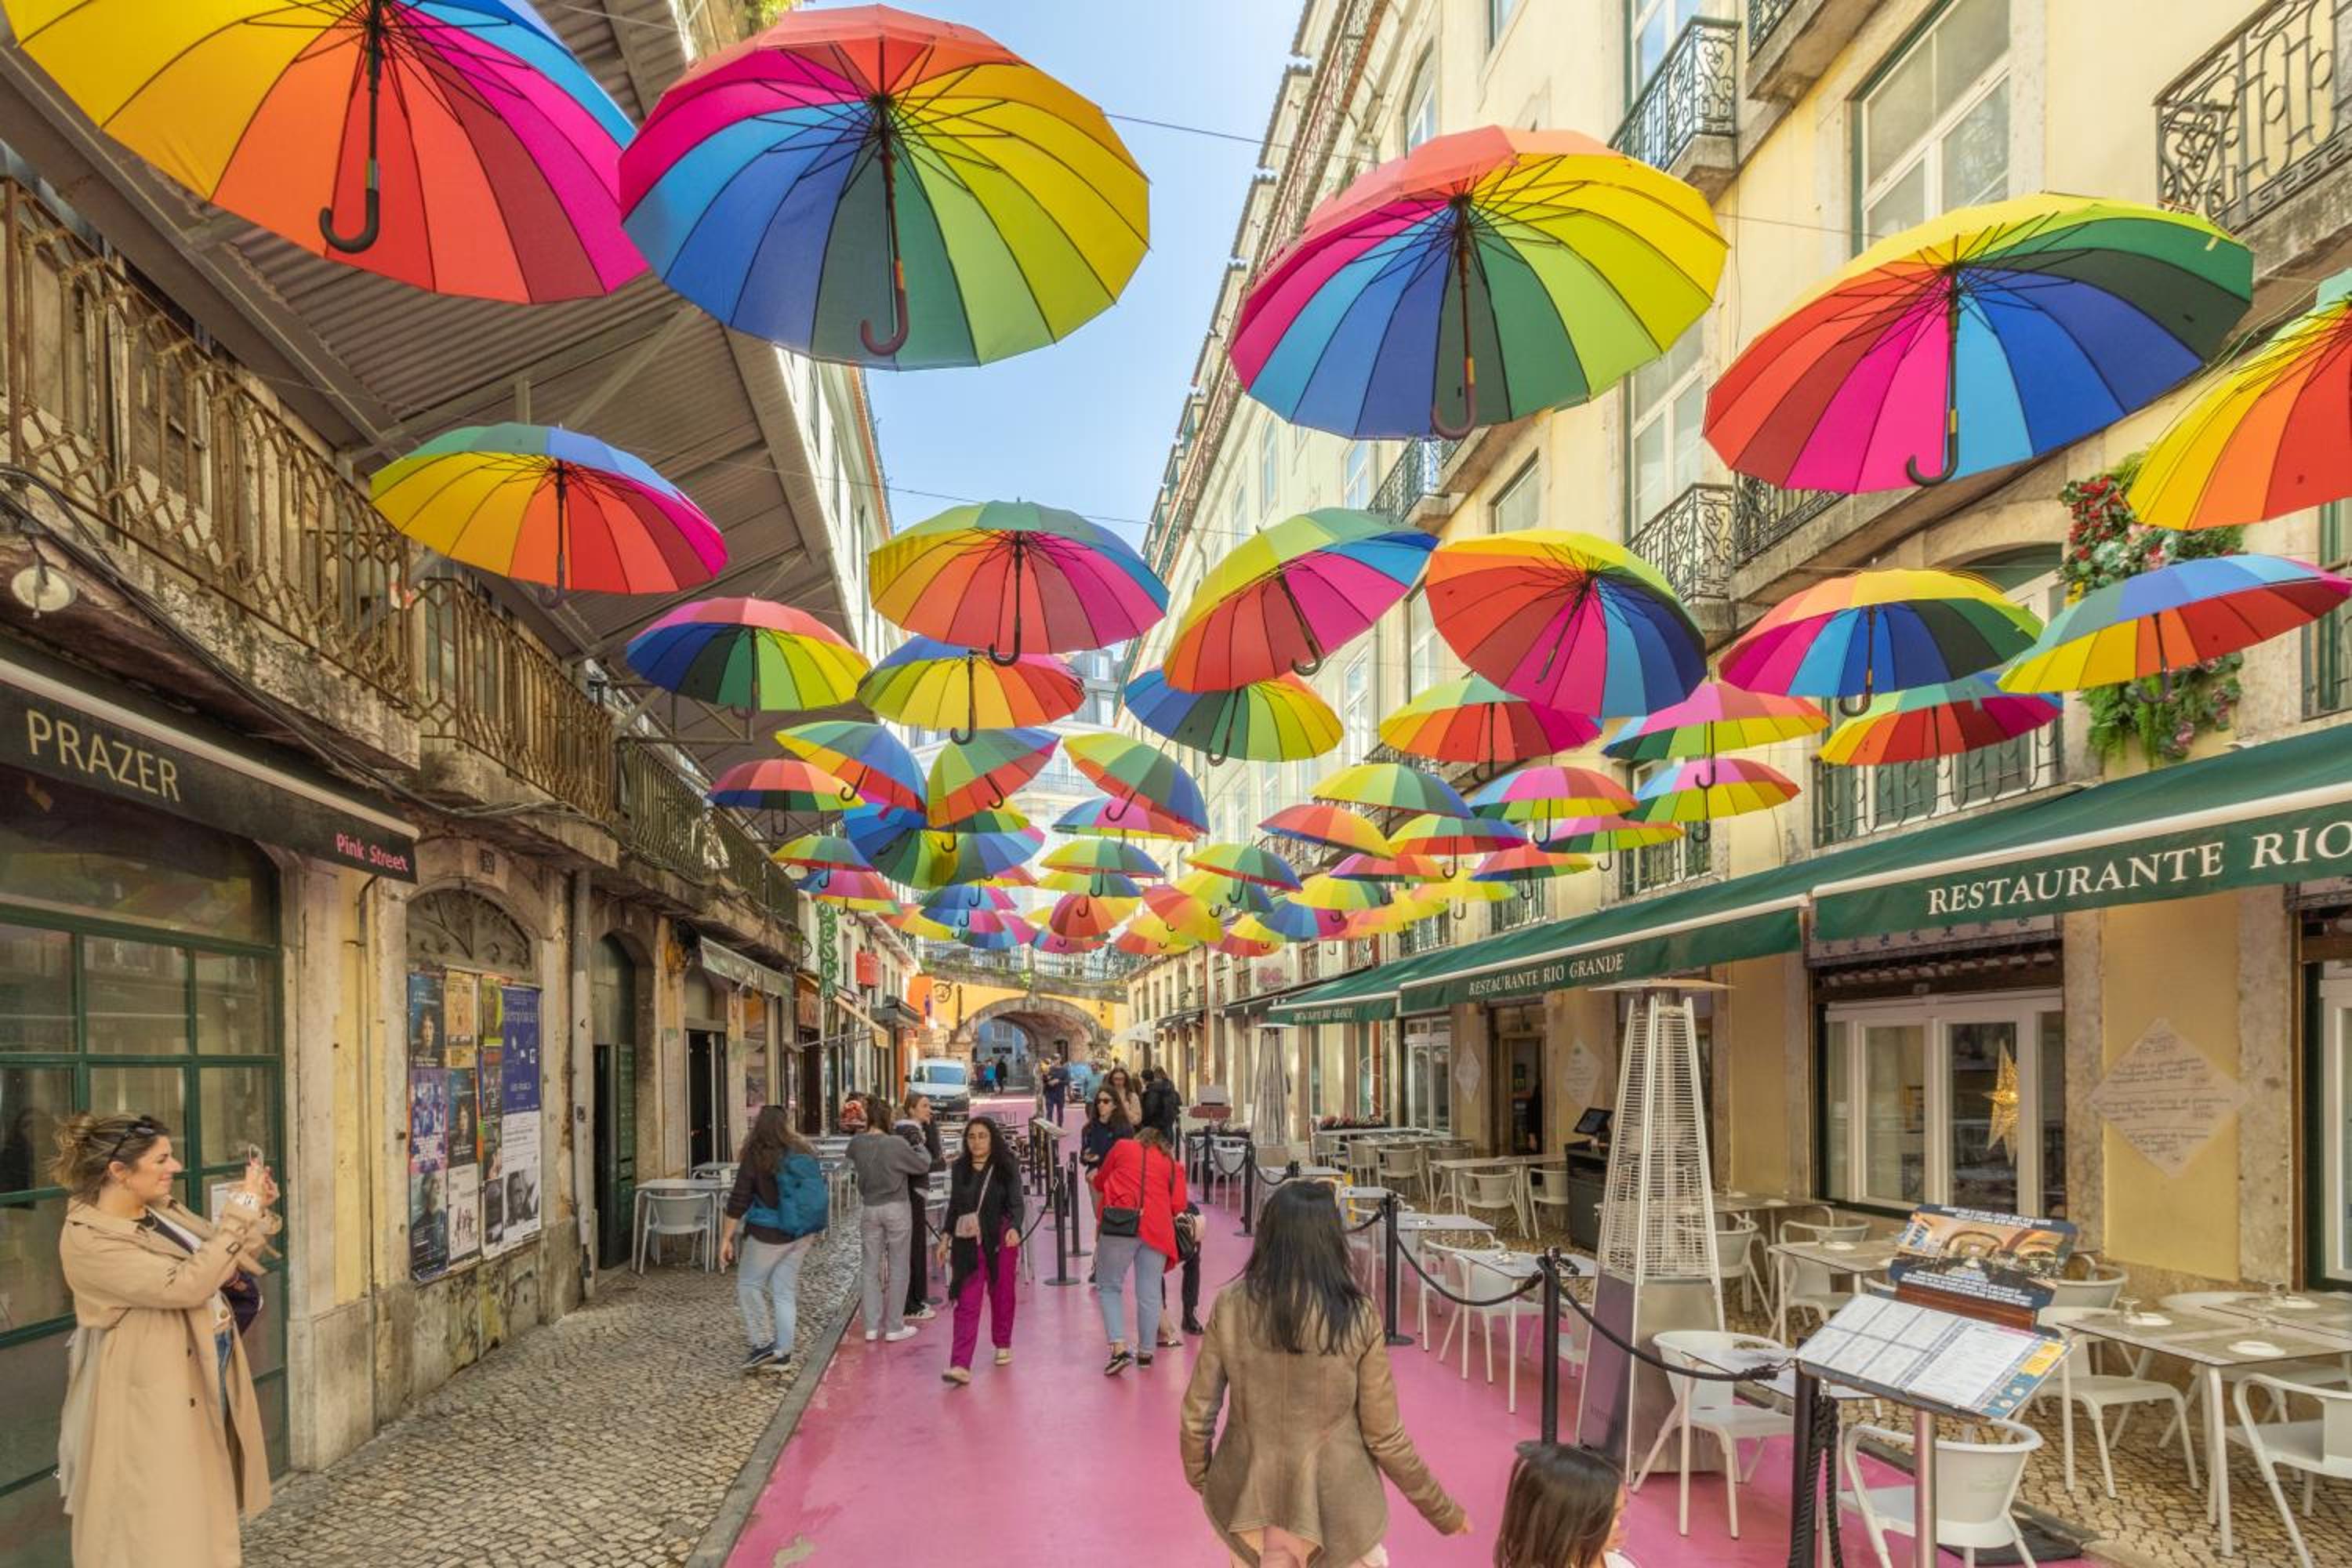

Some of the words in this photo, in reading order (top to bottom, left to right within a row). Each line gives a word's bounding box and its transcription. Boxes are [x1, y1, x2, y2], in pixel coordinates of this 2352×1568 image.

[27, 710, 180, 802] PRAZER
[336, 832, 365, 861] Pink
[369, 844, 408, 872] Street
[1927, 841, 2224, 916] RESTAURANTE
[2249, 821, 2352, 869] RIO
[1468, 969, 1538, 996] RESTAURANTE
[1544, 965, 1564, 983] RIO
[1569, 953, 1625, 978] GRANDE
